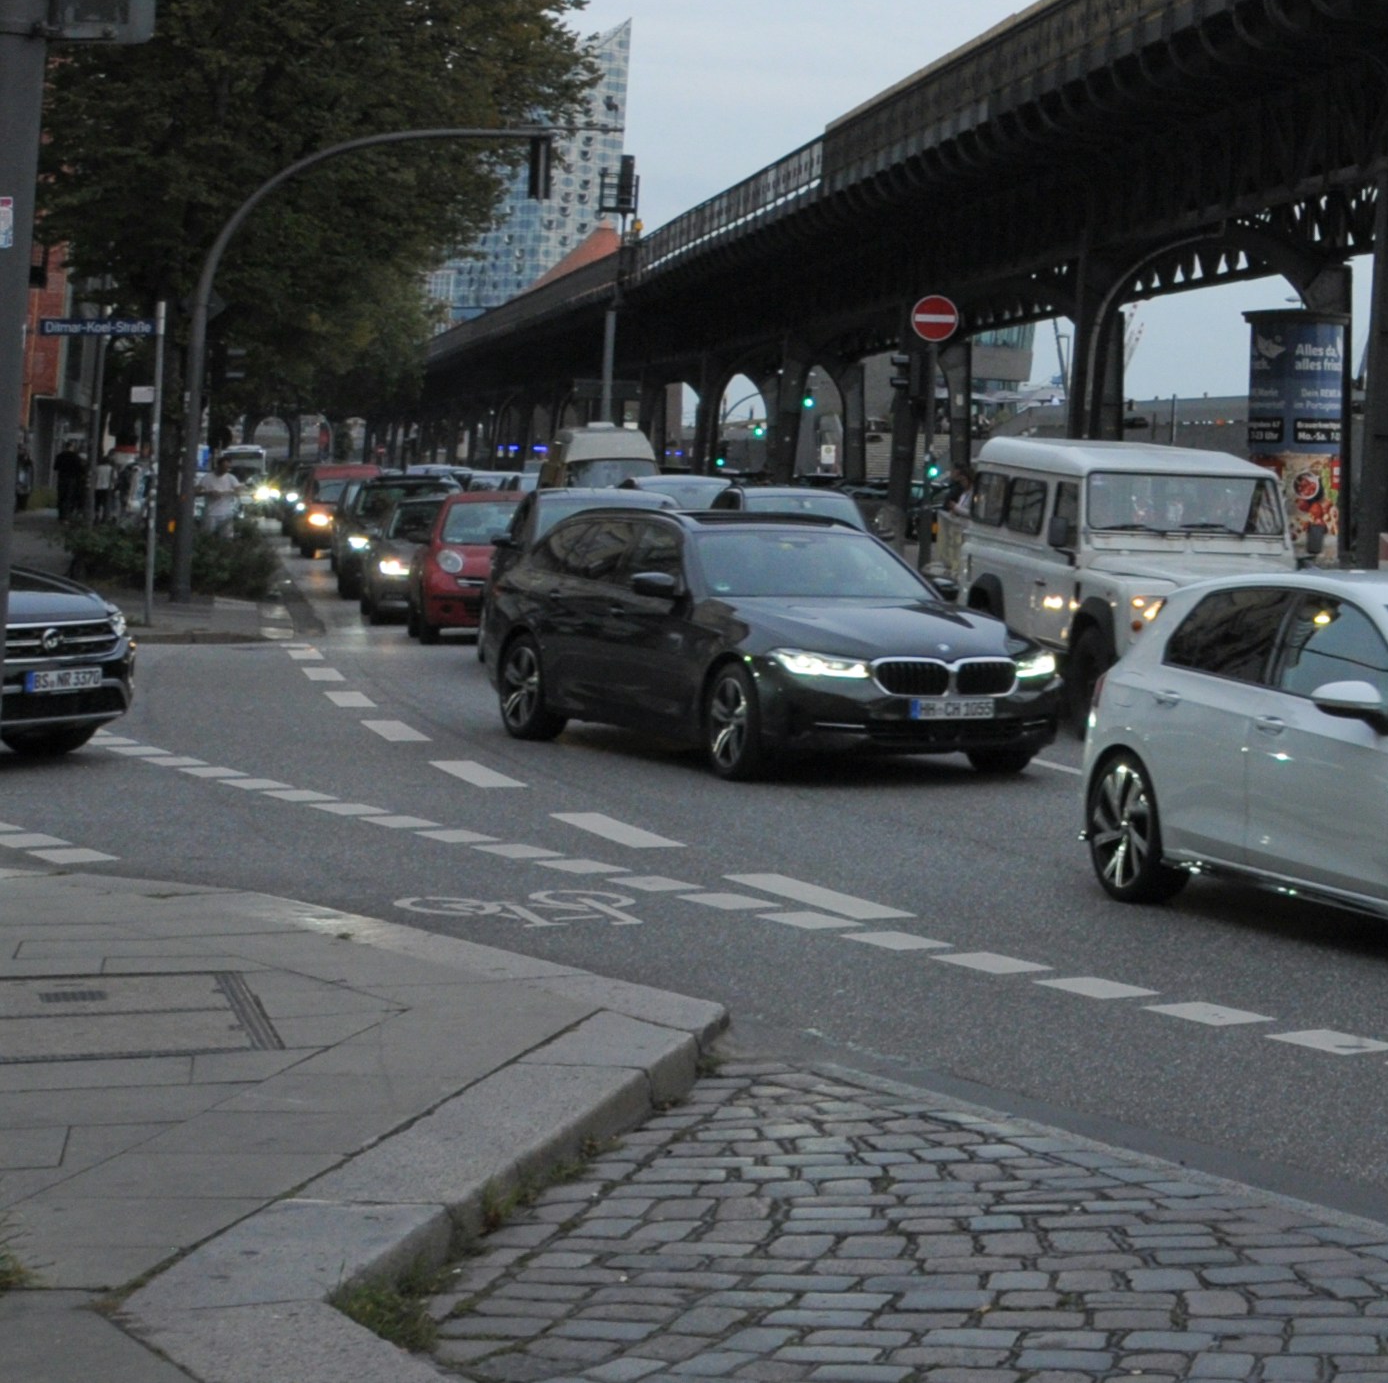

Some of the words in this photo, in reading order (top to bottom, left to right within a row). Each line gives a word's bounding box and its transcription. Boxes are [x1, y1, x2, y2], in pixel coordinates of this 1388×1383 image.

[44, 321, 152, 333] Ditmar-Koel-Straße
[1295, 344, 1323, 356] Alles
[1295, 358, 1321, 371] alles
